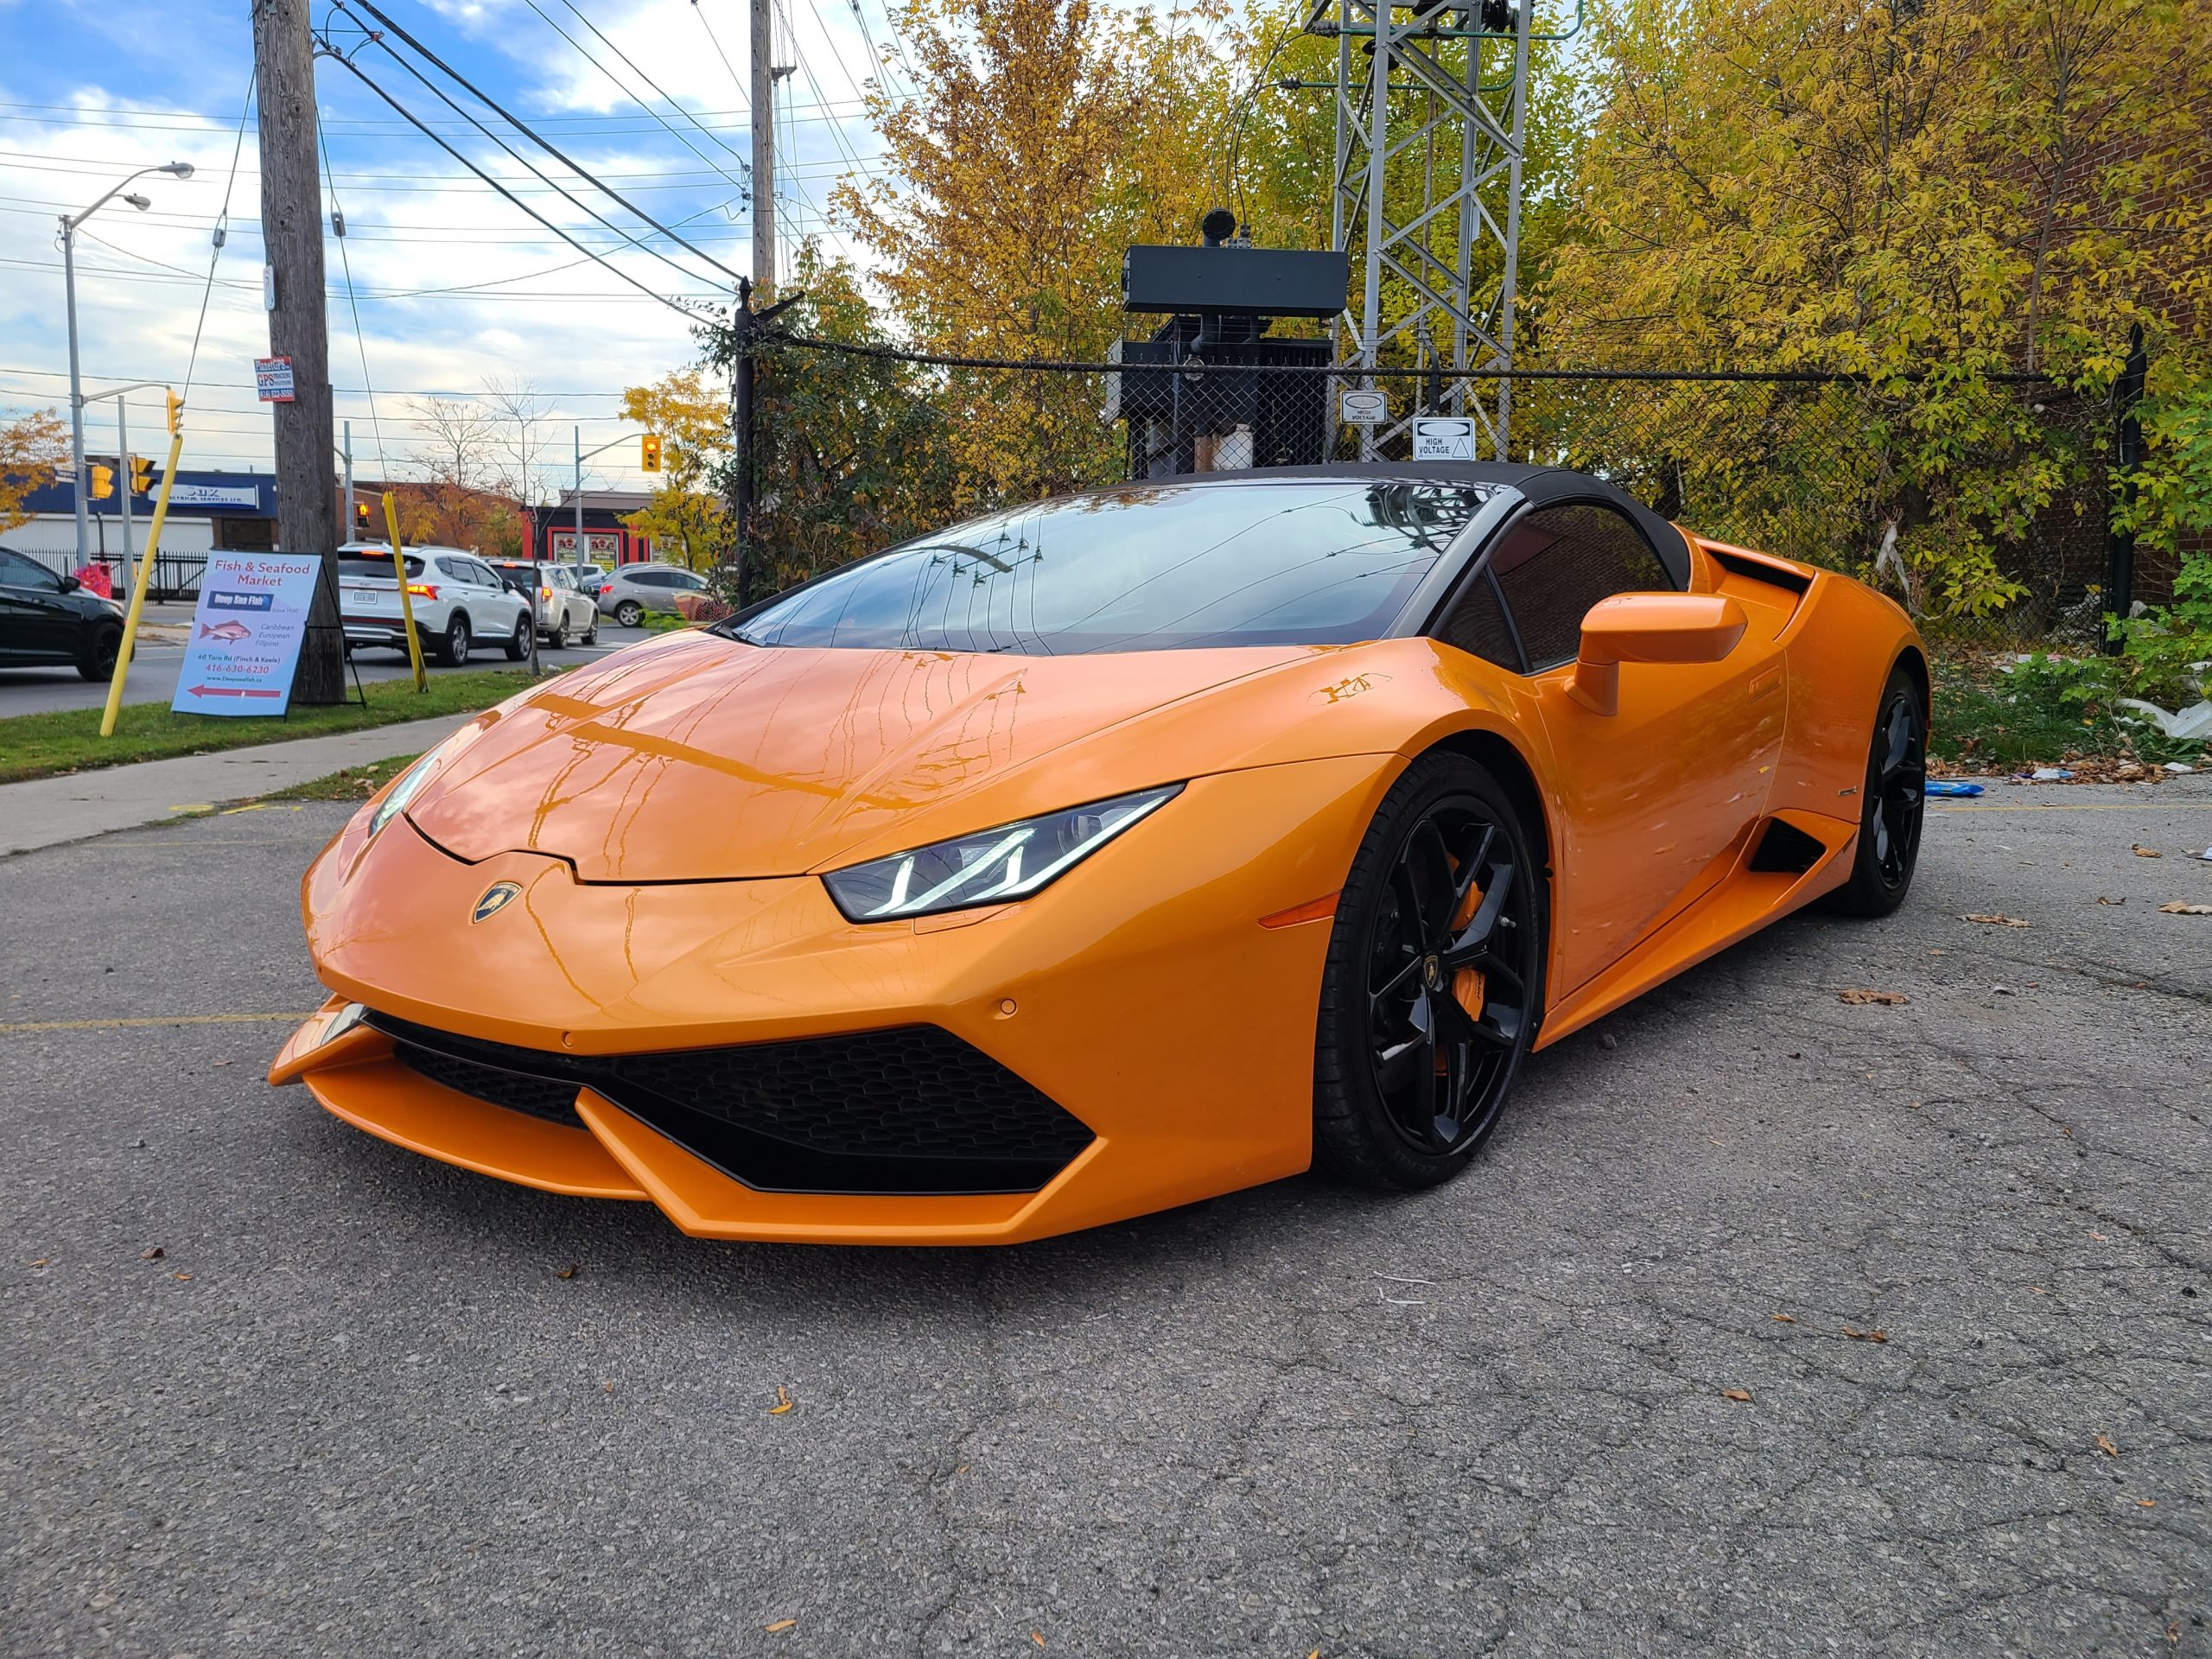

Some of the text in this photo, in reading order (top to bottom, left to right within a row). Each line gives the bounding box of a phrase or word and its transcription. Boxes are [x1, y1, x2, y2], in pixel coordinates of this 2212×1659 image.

[257, 373, 274, 387] GPS
[1426, 437, 1442, 446] HIGH
[215, 560, 310, 575] Fish & Seafood
[238, 575, 283, 586] Market
[214, 594, 263, 606] Deep Sea Fish
[258, 632, 290, 640] European
[206, 664, 270, 674] 416-630-6230
